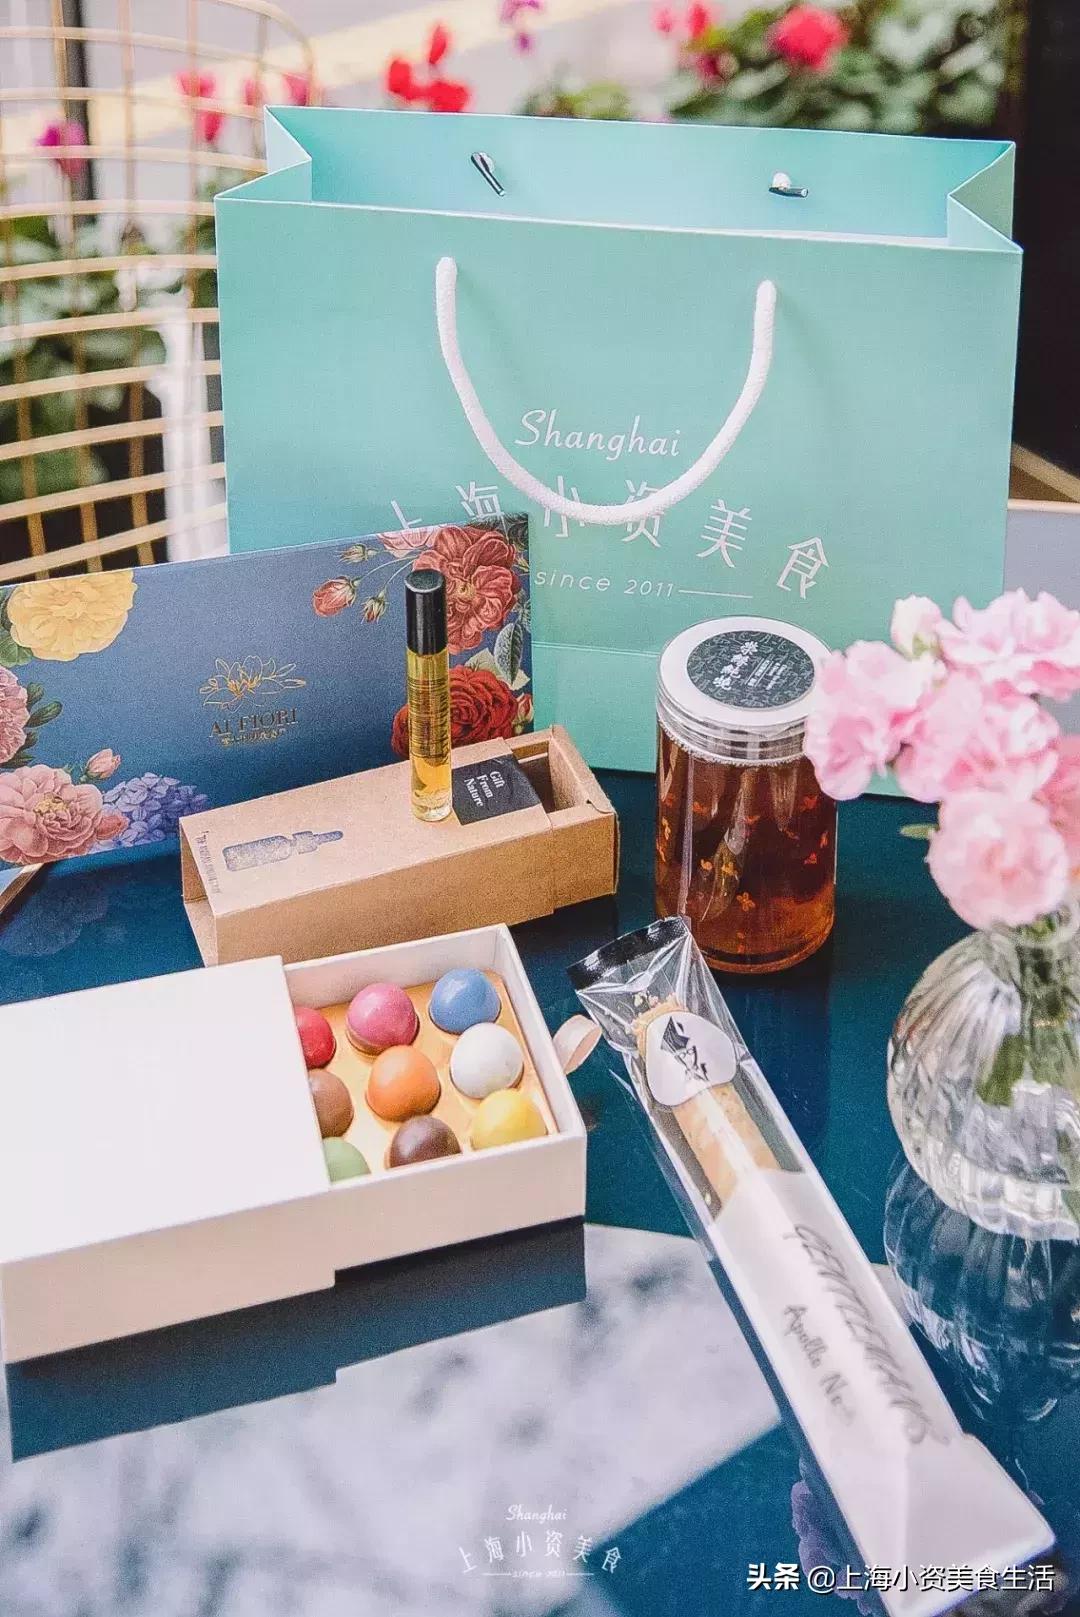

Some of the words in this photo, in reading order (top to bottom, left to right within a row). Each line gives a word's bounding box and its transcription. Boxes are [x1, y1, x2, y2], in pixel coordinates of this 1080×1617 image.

[515, 408, 681, 461] Shanghai
[534, 568, 611, 592] since
[623, 578, 674, 598] 2011
[238, 706, 299, 733] FIORI
[463, 777, 484, 808] Nature
[476, 774, 494, 799] From
[488, 770, 505, 790] Gift
